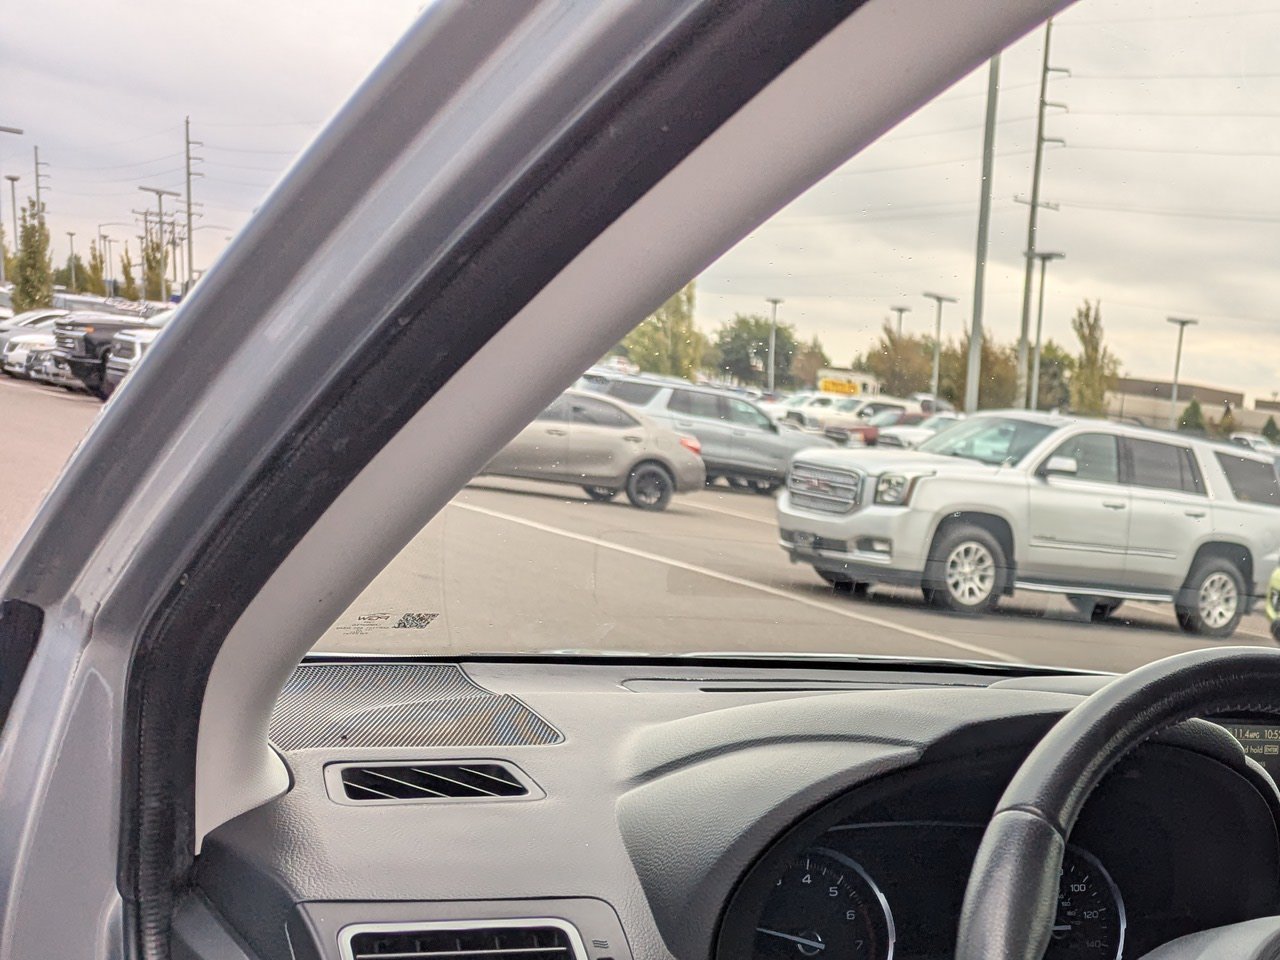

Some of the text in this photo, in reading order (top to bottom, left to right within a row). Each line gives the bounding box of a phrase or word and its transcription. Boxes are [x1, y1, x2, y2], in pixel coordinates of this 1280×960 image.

[802, 874, 812, 884] 4
[829, 887, 838, 897] 5
[1070, 883, 1086, 892] 100
[846, 910, 856, 920] 6
[1083, 911, 1099, 919] 120
[855, 939, 864, 950] 7
